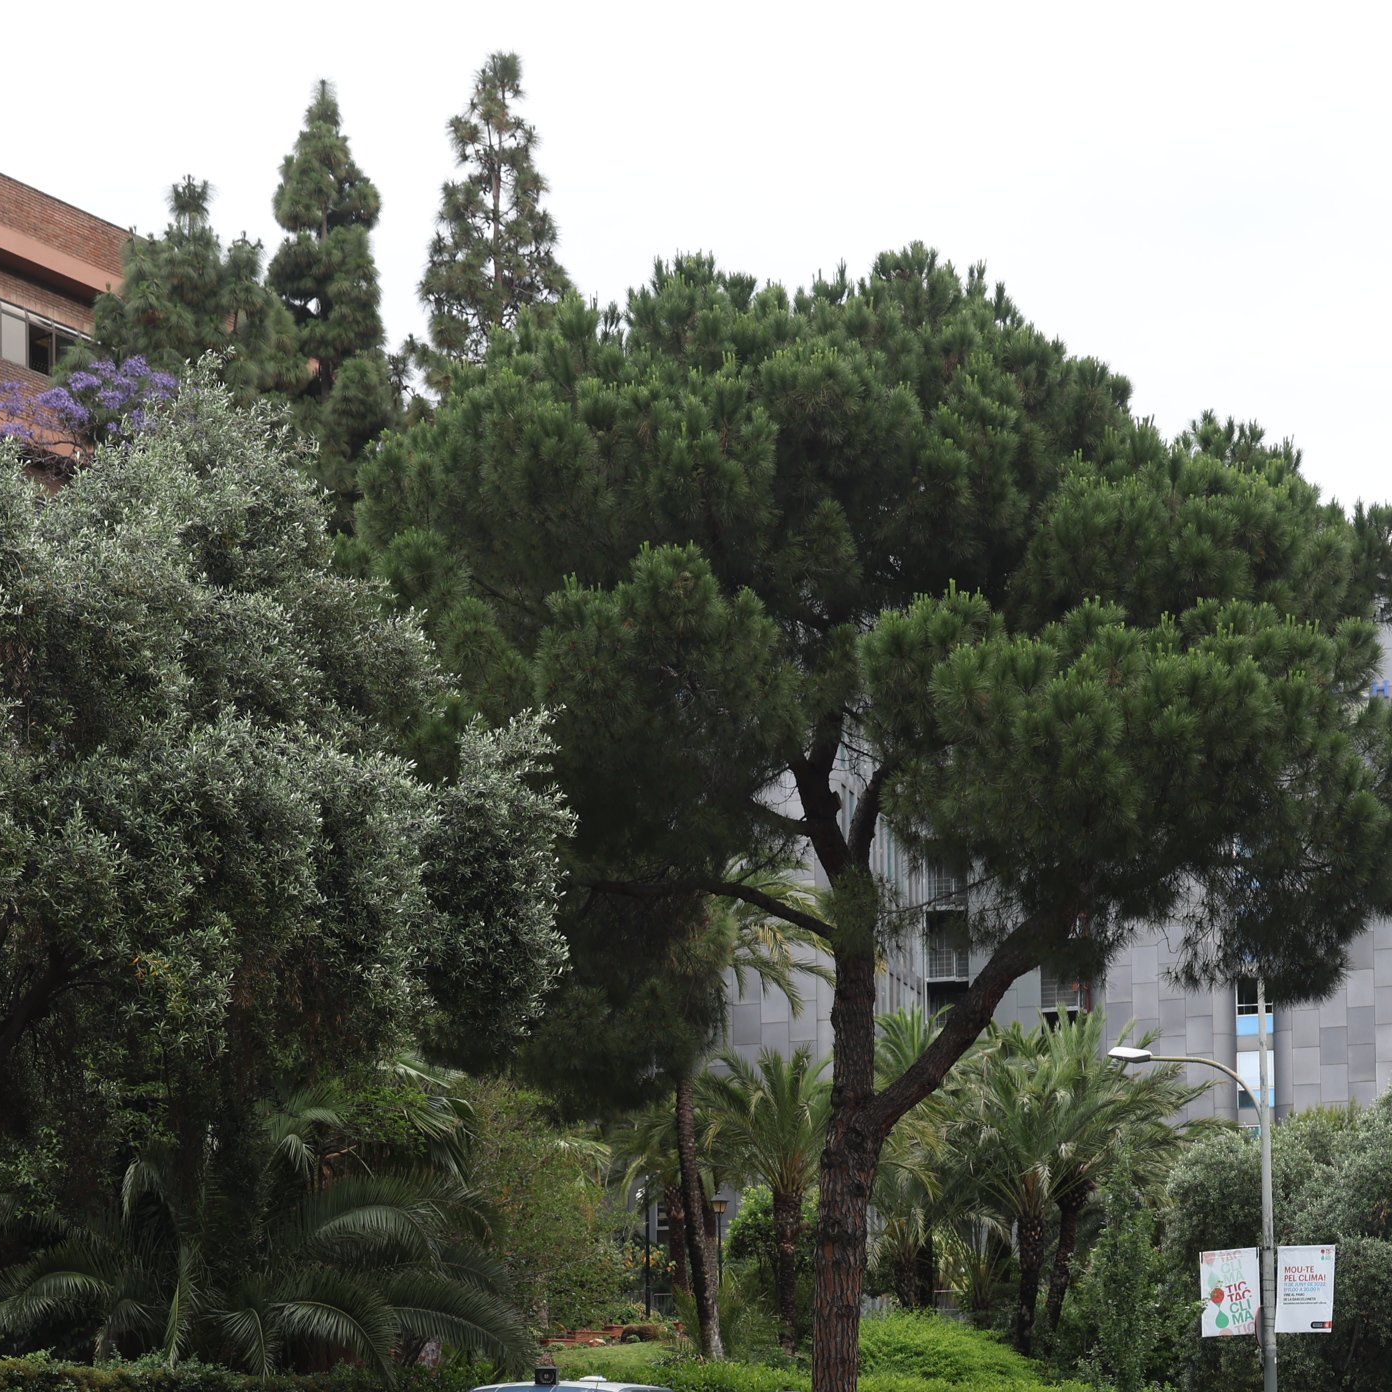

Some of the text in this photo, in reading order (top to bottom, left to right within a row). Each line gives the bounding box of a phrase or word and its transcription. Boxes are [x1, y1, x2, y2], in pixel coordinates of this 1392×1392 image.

[1284, 1265, 1314, 1273] MOU-TE
[1284, 1274, 1297, 1282] PEL
[1230, 1298, 1251, 1313] CLI
[1232, 1310, 1254, 1325] MA
